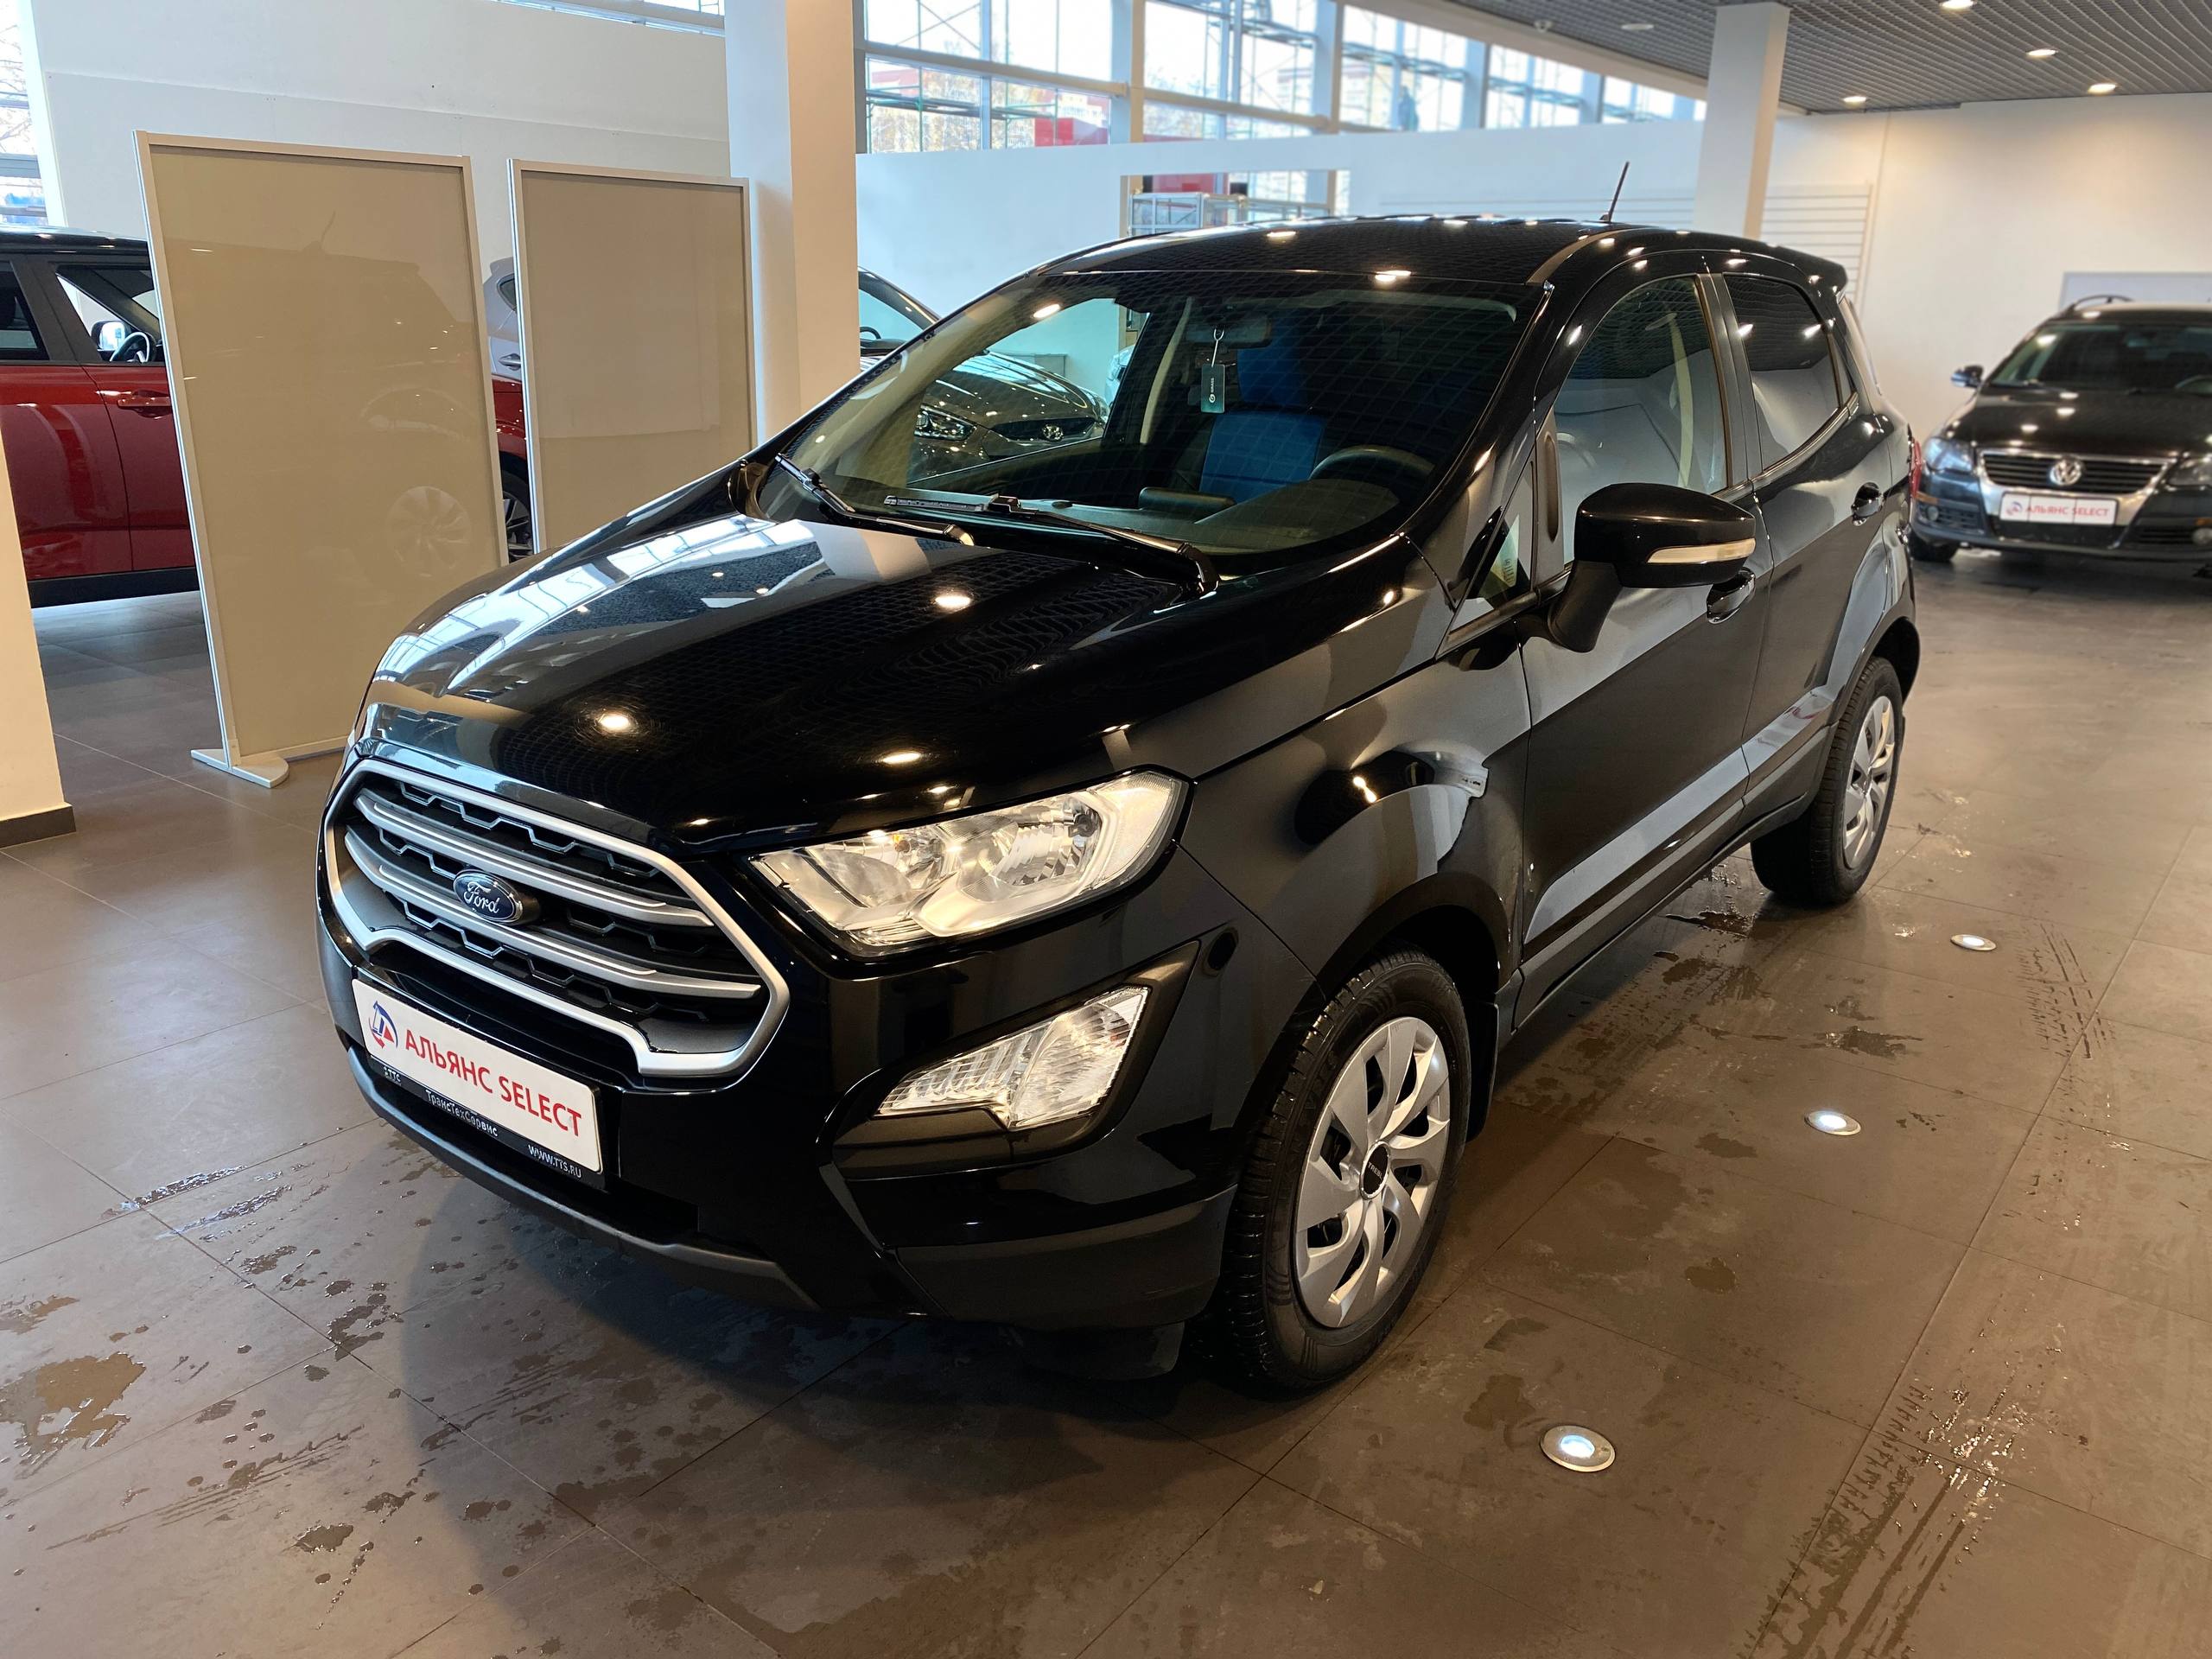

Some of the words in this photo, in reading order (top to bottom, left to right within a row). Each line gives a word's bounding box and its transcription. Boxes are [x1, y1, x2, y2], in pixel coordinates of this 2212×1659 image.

[2025, 505, 2069, 516] АЛЬЯНС
[2072, 506, 2109, 517] SELECT
[463, 880, 499, 914] Ford
[405, 1029, 493, 1094] АЛЬЯНС
[500, 1076, 582, 1136] SELECT
